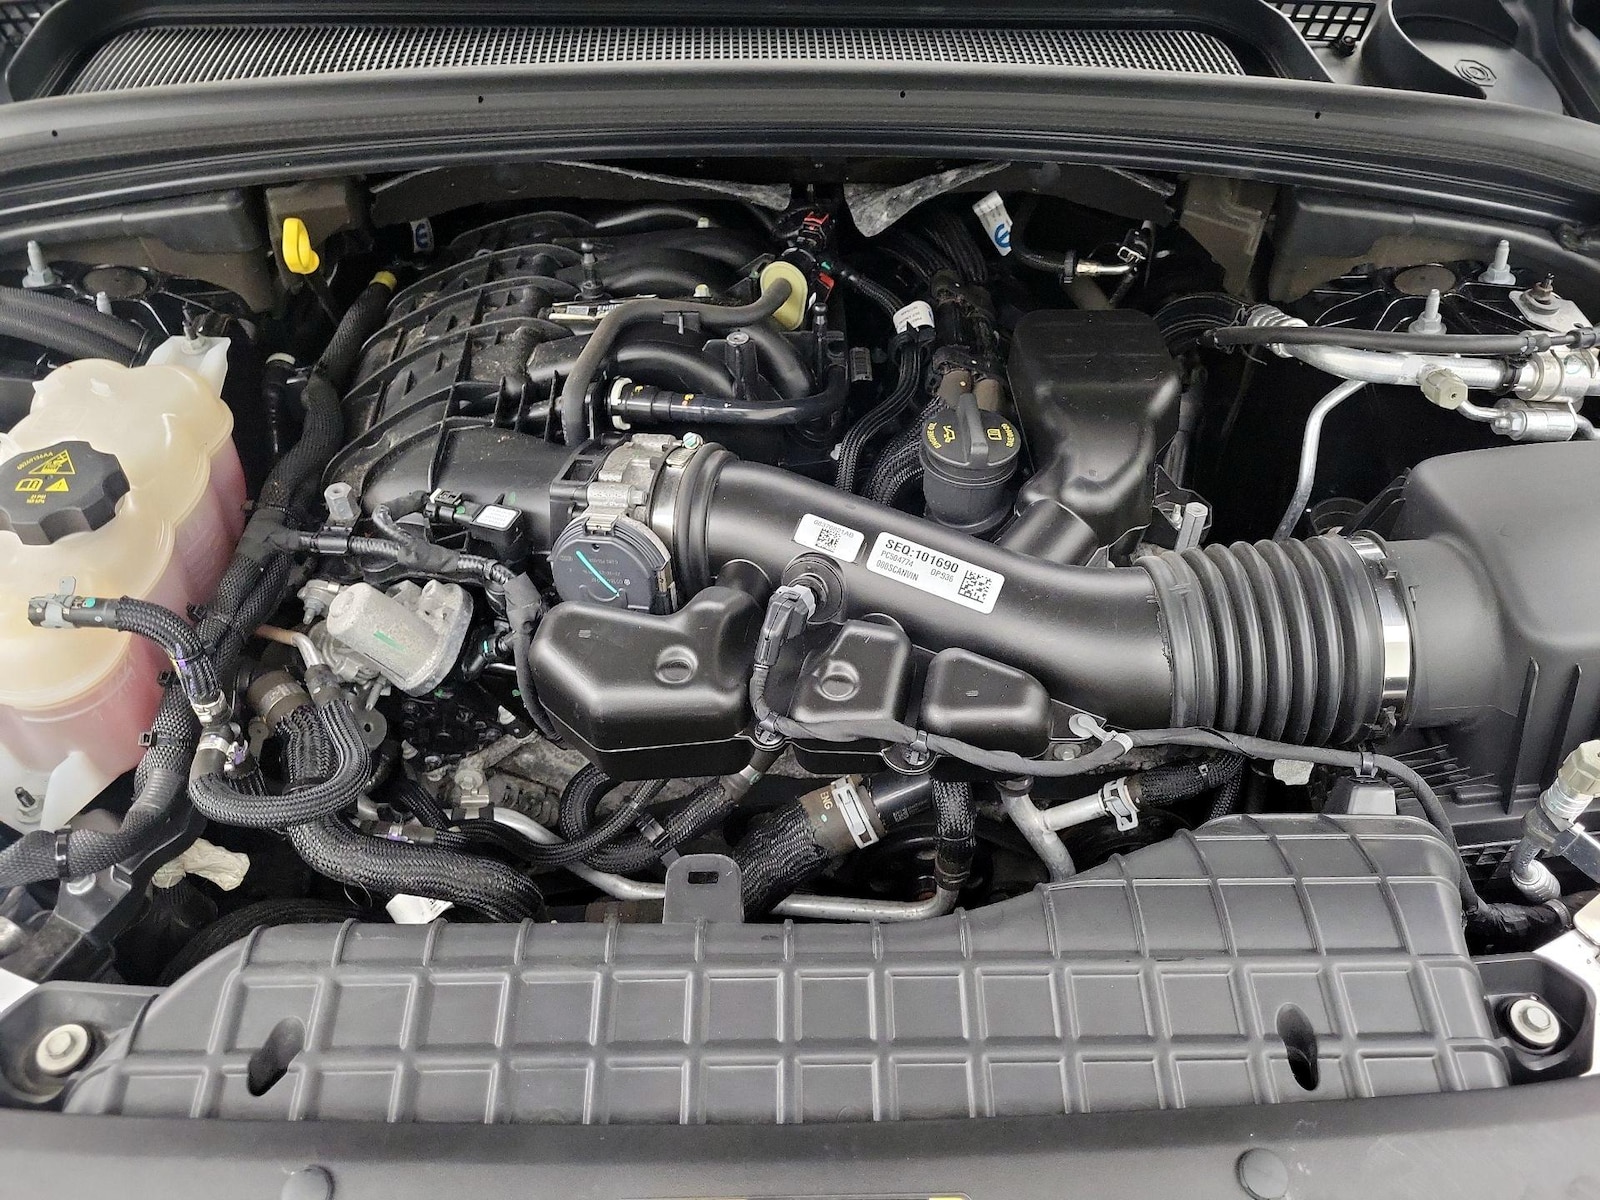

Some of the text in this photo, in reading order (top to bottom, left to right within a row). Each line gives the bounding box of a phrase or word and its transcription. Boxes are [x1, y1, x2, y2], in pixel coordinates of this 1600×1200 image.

[880, 550, 914, 567] PC504774
[885, 539, 959, 573] SEQ:101690
[820, 791, 833, 810] ENG
